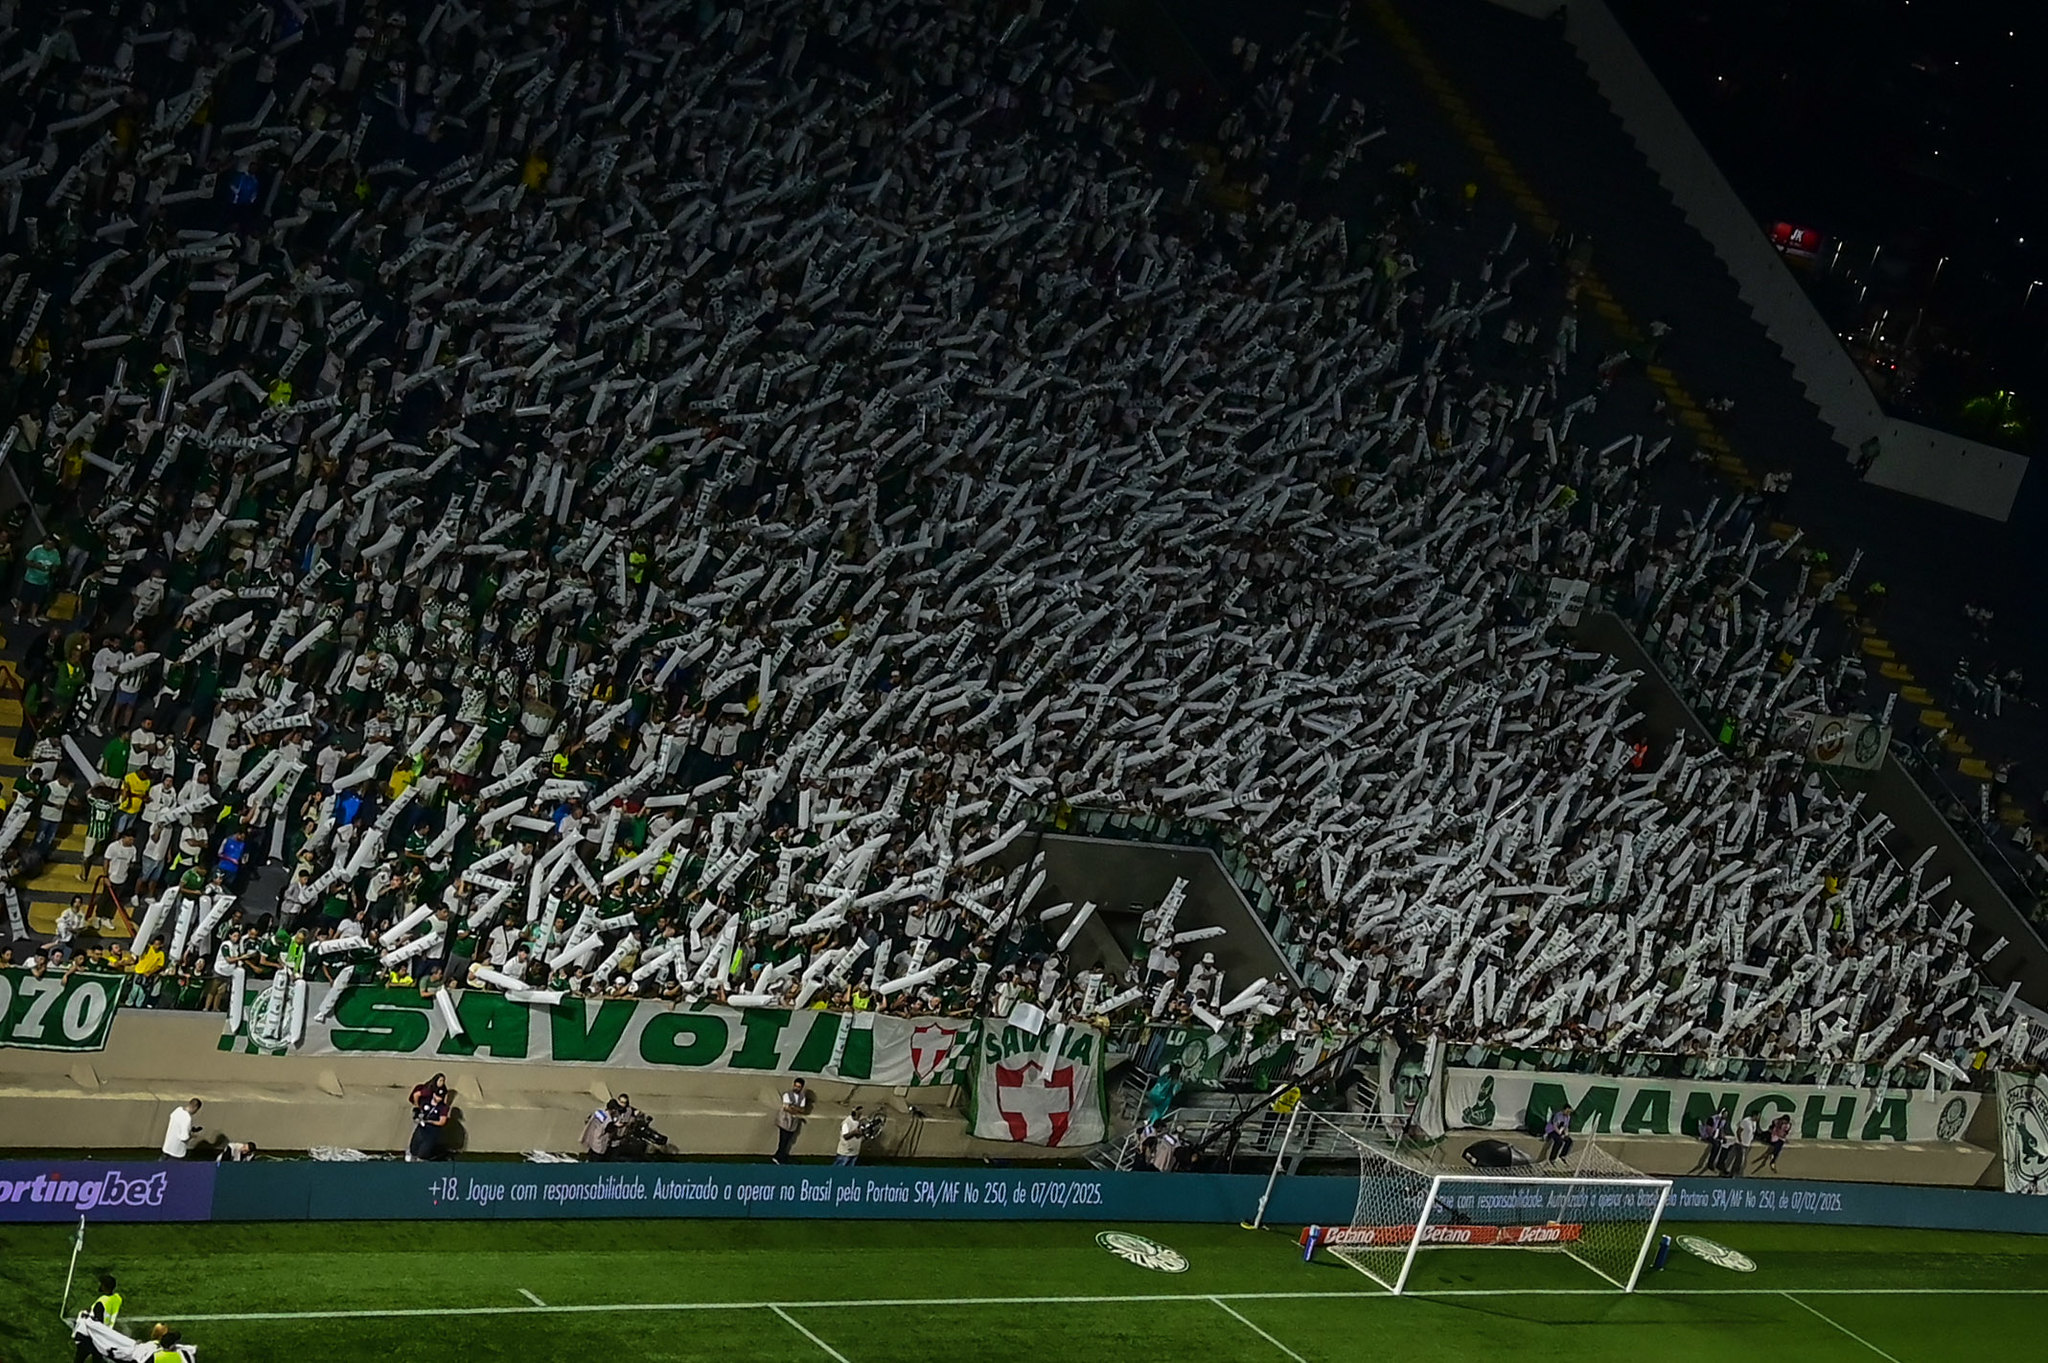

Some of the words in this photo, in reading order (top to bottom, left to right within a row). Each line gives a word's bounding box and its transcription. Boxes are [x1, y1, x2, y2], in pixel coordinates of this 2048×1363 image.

[95, 809, 107, 822] 10
[0, 974, 107, 1041] 70
[1525, 1082, 1909, 1142] MANCHA
[428, 1177, 460, 1201] +18.
[465, 1177, 505, 1206] Jogue
[510, 1183, 538, 1201] com
[542, 1175, 648, 1206] responsabilidade.
[652, 1176, 719, 1201] Autorizado
[723, 1185, 732, 1201] a
[736, 1184, 775, 1206] operar
[779, 1185, 796, 1202] no
[799, 1178, 833, 1202] Brasil
[835, 1178, 861, 1207] pela
[866, 1180, 910, 1203] Portaria
[914, 1180, 961, 1208] SPA/MF
[964, 1182, 980, 1204] No
[983, 1182, 1008, 1208] 250,
[1012, 1180, 1027, 1204] de
[1031, 1181, 1103, 1209] 07/02/2025.
[1679, 1189, 1708, 1208] Portaria
[1711, 1189, 1742, 1211] SPA/MF
[1745, 1190, 1757, 1209] No
[1758, 1190, 1776, 1211] 250,
[1778, 1190, 1789, 1210] de
[1791, 1190, 1843, 1214] 07/02/2025.
[1323, 1227, 1375, 1244] Betano
[1420, 1226, 1471, 1242] Betano
[1517, 1226, 1561, 1242] Betano
